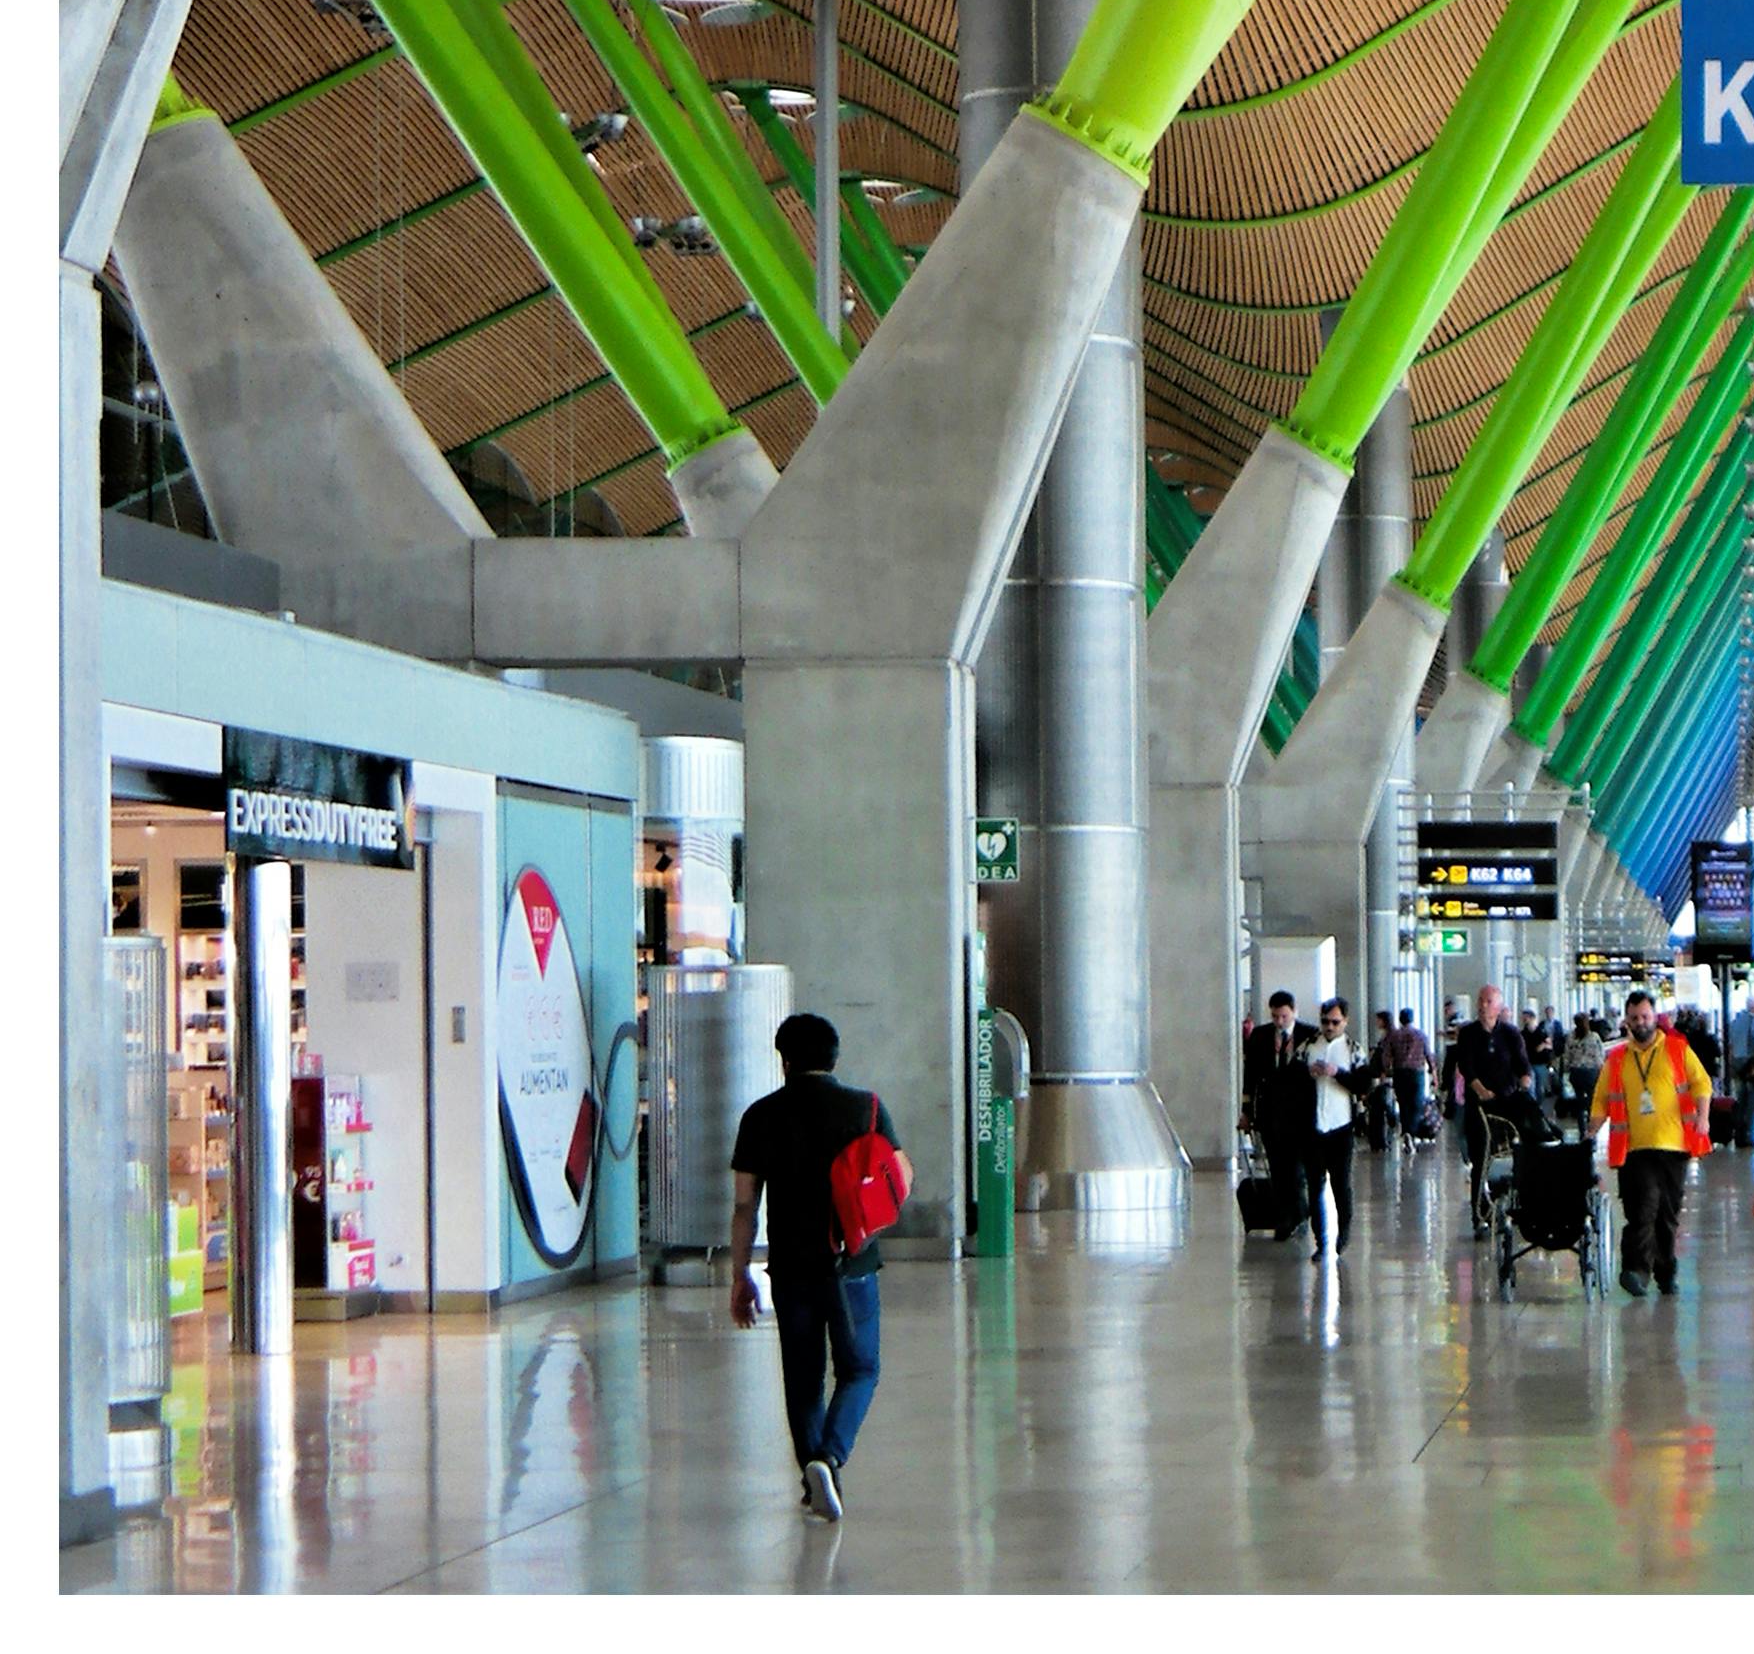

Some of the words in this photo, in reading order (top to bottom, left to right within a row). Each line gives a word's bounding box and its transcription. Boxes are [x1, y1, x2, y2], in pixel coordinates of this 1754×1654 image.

[977, 866, 1016, 880] DEA
[1470, 867, 1498, 882] K62
[1503, 867, 1532, 882] K64
[520, 1069, 568, 1095] AUMENTAN
[979, 1018, 992, 1142] DESFIBRILADOR
